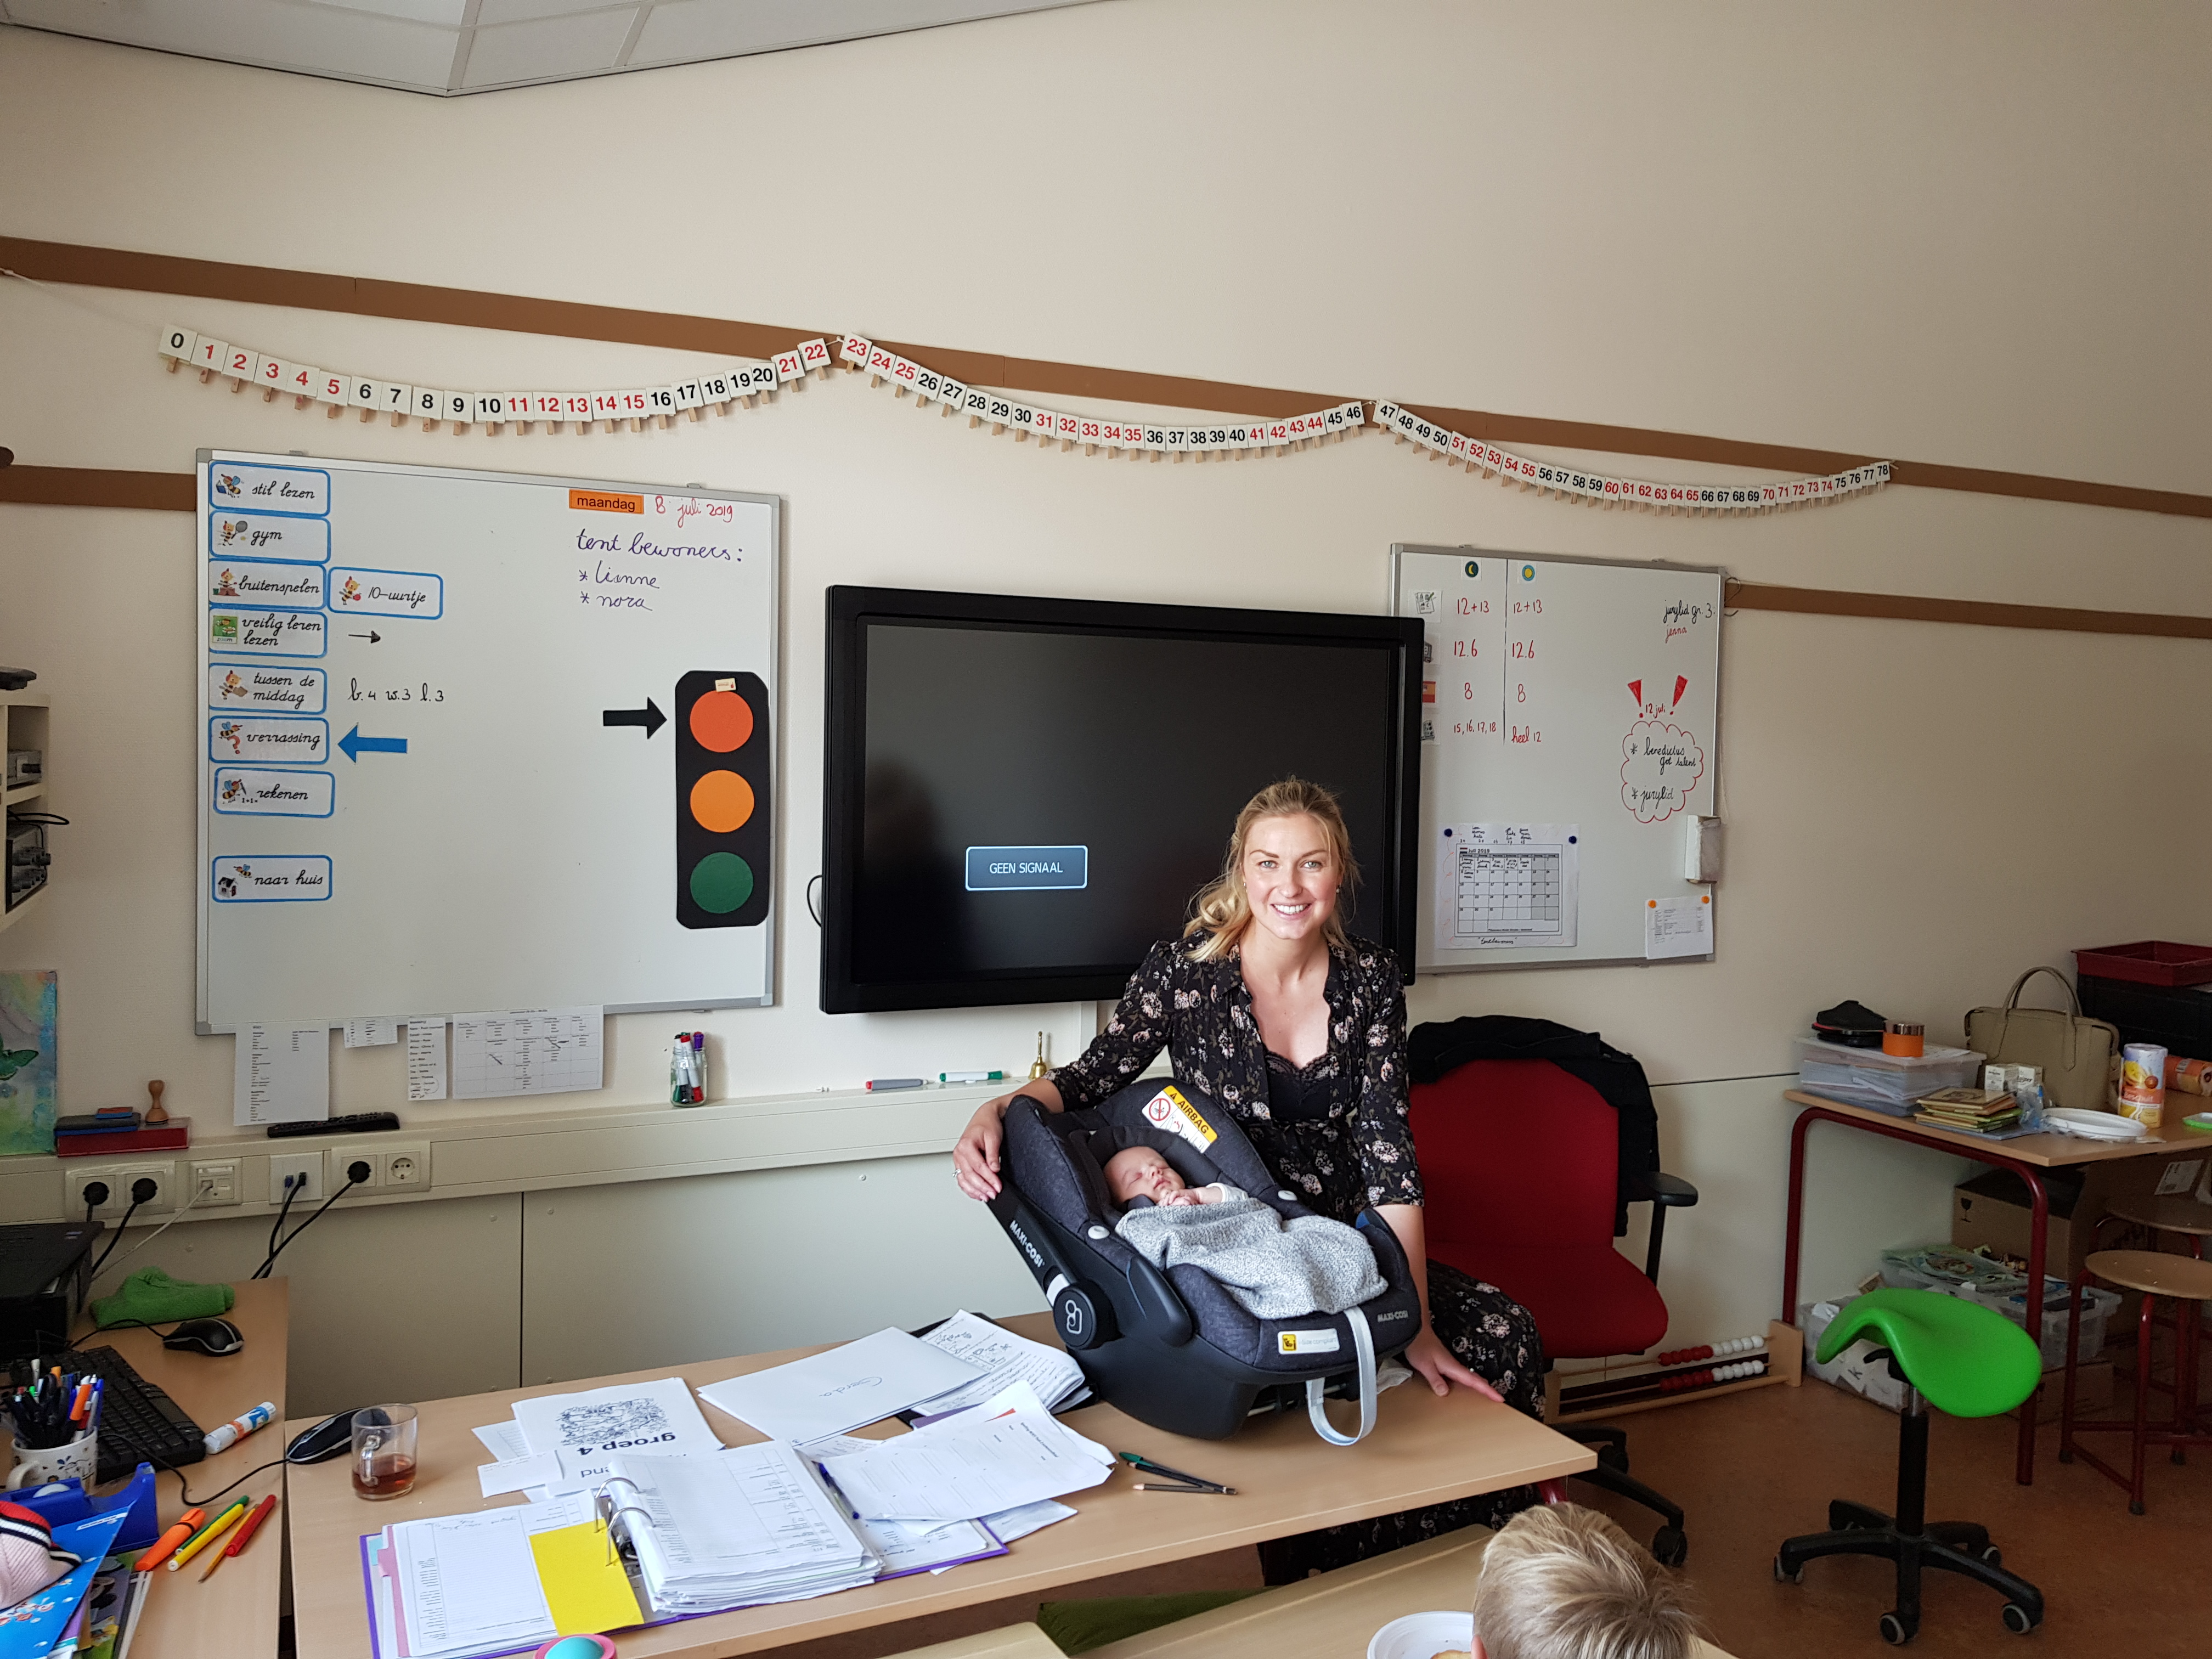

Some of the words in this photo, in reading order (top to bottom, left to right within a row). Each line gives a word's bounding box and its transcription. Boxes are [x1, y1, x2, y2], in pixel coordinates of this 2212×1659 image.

[171, 332, 184, 348] 0
[206, 345, 213, 359] 1
[233, 354, 247, 370] 2
[266, 363, 279, 379] 3
[296, 371, 308, 386] 4
[328, 379, 340, 394] 5
[359, 383, 371, 399] 6
[390, 388, 401, 403] 7
[421, 393, 433, 409] 8
[453, 397, 464, 413] 9
[479, 398, 501, 413] 10
[509, 398, 528, 411] 11
[538, 397, 560, 412] 12
[567, 398, 589, 413] 13
[596, 396, 617, 410] 14
[624, 394, 645, 409] 15
[651, 392, 671, 406] 16
[677, 384, 695, 400] 17
[704, 380, 725, 395] 18
[730, 373, 751, 388] 19
[753, 368, 773, 382] 20
[779, 357, 798, 373] 21
[805, 344, 826, 360] 22
[847, 338, 867, 356] 23
[871, 352, 891, 370] 24
[895, 362, 916, 380] 25
[918, 373, 938, 391] 26
[943, 383, 963, 399] 27
[967, 394, 986, 410] 28
[991, 402, 1009, 417] 29
[1014, 408, 1031, 423] 30
[1036, 414, 1052, 427] 31
[1059, 418, 1077, 433] 32
[1082, 422, 1099, 437] 33
[1104, 426, 1121, 439] 34
[1125, 428, 1142, 441] 35
[1147, 430, 1163, 444] 36
[1169, 431, 1184, 444] 37
[1190, 431, 1206, 444] 38
[1209, 430, 1226, 443] 39
[1229, 429, 1245, 442] 40
[1250, 428, 1264, 440] 41
[1271, 425, 1286, 438] 42
[1290, 420, 1305, 432] 43
[1307, 416, 1323, 429] 44
[1328, 411, 1342, 425] 45
[1346, 406, 1361, 419] 46
[1380, 405, 1396, 419] 47
[1398, 415, 1413, 430] 48
[1415, 424, 1431, 438] 49
[1433, 431, 1448, 446] 50
[1452, 437, 1465, 452] 51
[1469, 443, 1484, 458] 52
[1487, 450, 1502, 465] 53
[1504, 458, 1518, 472] 54
[1521, 463, 1536, 477] 55
[1538, 467, 1553, 481] 56
[1555, 471, 1570, 484] 57
[1572, 475, 1585, 488] 58
[1588, 478, 1602, 492] 59
[1605, 482, 1619, 494] 60
[1623, 482, 1634, 494] 61
[1639, 485, 1652, 496] 62
[1655, 488, 1667, 500] 63
[1671, 488, 1683, 500] 64
[1686, 490, 1699, 501] 65
[1701, 490, 1714, 503] 66
[1717, 490, 1730, 503] 67
[1733, 490, 1745, 503] 68
[1747, 490, 1759, 502] 69
[1763, 489, 1775, 500] 70
[1778, 487, 1788, 497] 71
[1792, 484, 1804, 496] 72
[1807, 482, 1819, 493] 73
[1821, 481, 1833, 492] 74
[1835, 477, 1847, 489] 75
[1849, 473, 1861, 484] 76
[1863, 469, 1875, 480] 77
[1877, 465, 1888, 477] 78
[251, 481, 277, 496] stil
[280, 482, 315, 499] lezen
[577, 496, 635, 512] maandag
[677, 497, 702, 528] juli
[706, 504, 733, 522] 2019
[250, 529, 283, 546] gym
[576, 528, 622, 551] tent
[238, 575, 320, 594] buitenspelen
[596, 595, 653, 611] nora
[242, 613, 284, 636] veilig
[287, 614, 322, 632] leren
[243, 630, 279, 646] lezen
[253, 673, 293, 687] tussen
[299, 675, 315, 687] de
[253, 690, 305, 710] middag
[246, 732, 320, 751] verrassing
[256, 783, 309, 800] rekenen
[989, 862, 1016, 874] GEEN
[1019, 862, 1063, 873] SIGNAAL
[254, 876, 289, 886] naar
[295, 870, 323, 885] huis
[1177, 1100, 1210, 1135] AIRBAG
[602, 1432, 676, 1451] groep
[577, 1447, 594, 1456] 4
